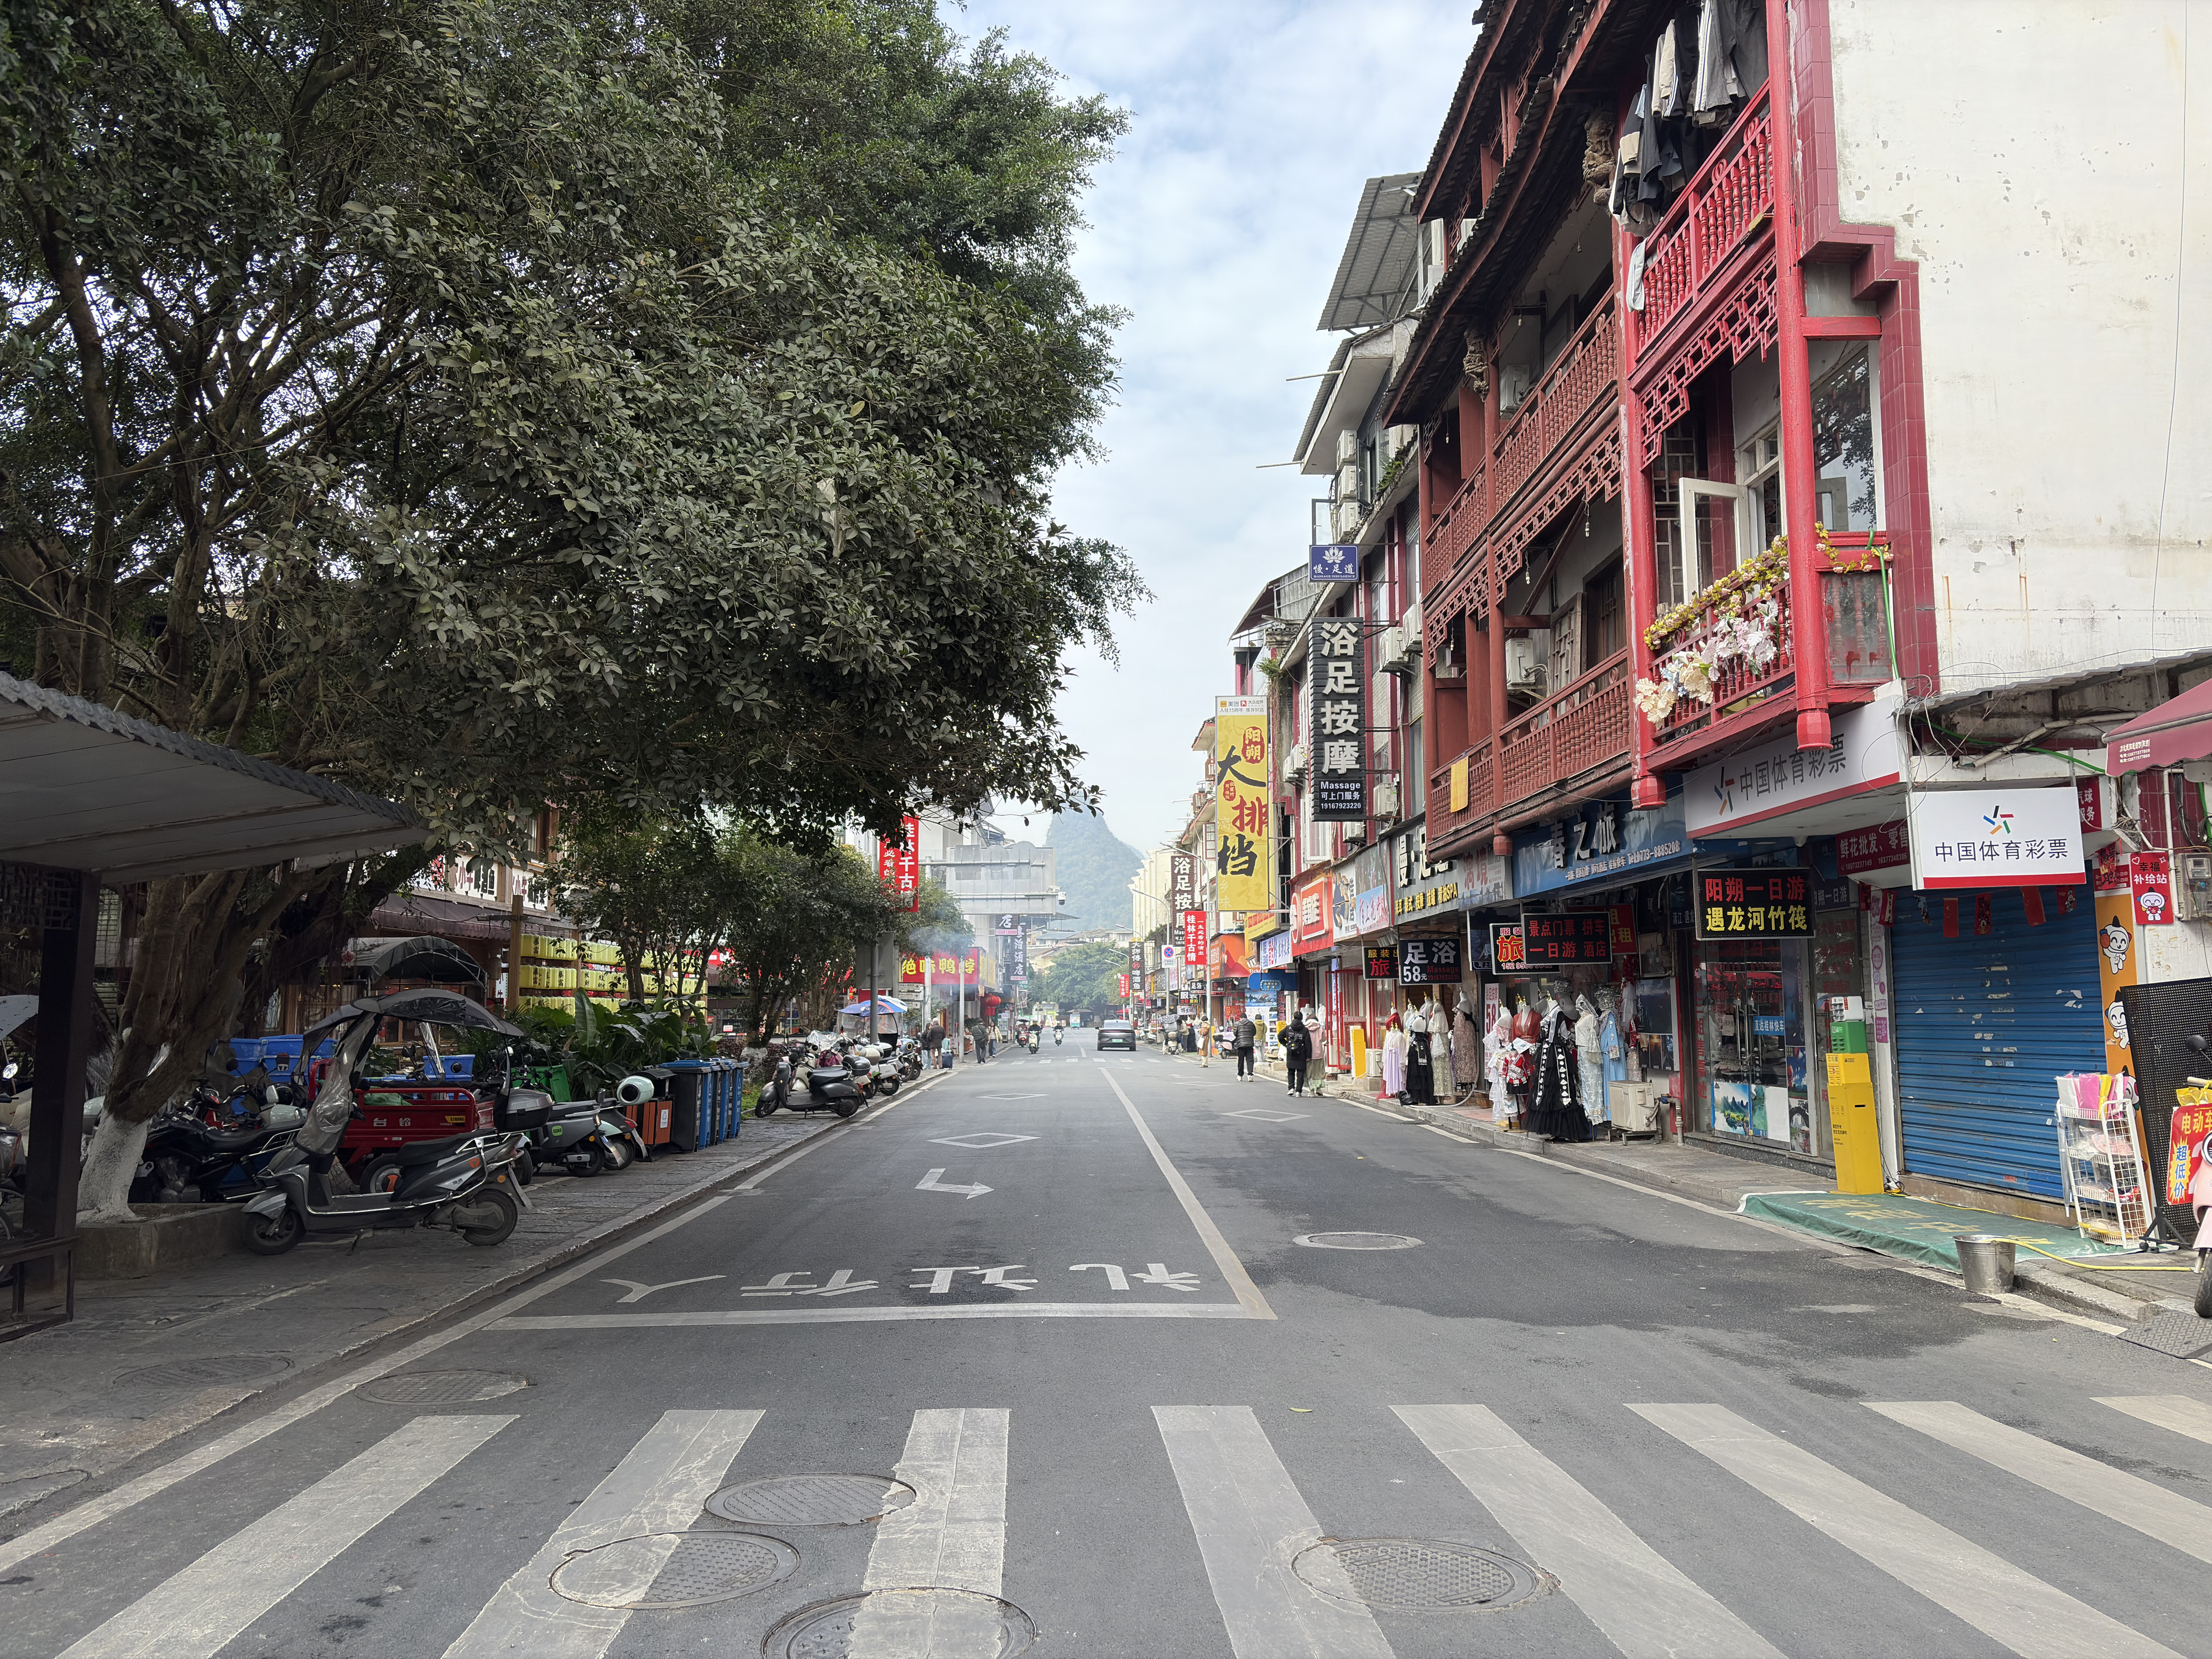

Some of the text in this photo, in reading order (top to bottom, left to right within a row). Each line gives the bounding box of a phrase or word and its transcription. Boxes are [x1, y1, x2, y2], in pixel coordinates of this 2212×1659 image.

[1313, 563, 1355, 575] 慢·足道
[1320, 622, 1360, 774] 浴足按摩
[1244, 727, 1261, 760] 阳朔
[1740, 733, 1846, 801] 中国体育彩票
[1321, 781, 1361, 790] Massage
[1321, 791, 1360, 800] 可上门服务
[1934, 837, 2068, 863] 中国体育彩票
[1845, 852, 1907, 870] 18073237149 18377348386
[2138, 862, 2161, 872] 幸福
[1705, 875, 1806, 902] 阳朔一日游
[2133, 873, 2167, 885] 补给站
[1174, 857, 1192, 928] 浴足按摩
[1438, 882, 1458, 904] 精油SPA
[999, 914, 1013, 928] 店
[1528, 919, 1605, 937] 景点门票 拼车
[1705, 905, 1808, 932] 遇龙河竹筏
[1186, 914, 1196, 962] 桂林千古情
[1500, 927, 1523, 936] 服装
[1131, 941, 1141, 962] 大师傅
[1404, 941, 1457, 966] 足浴
[1529, 940, 1606, 959] 一日游 酒店
[902, 957, 975, 976] 绝味鸭脖
[1404, 966, 1428, 983] 58元
[1132, 970, 1141, 990] 啤酒鱼
[1754, 1018, 1785, 1032] 直达桂林快车
[2182, 1109, 2212, 1134] 电动车
[2173, 1145, 2187, 1198] 超低价
